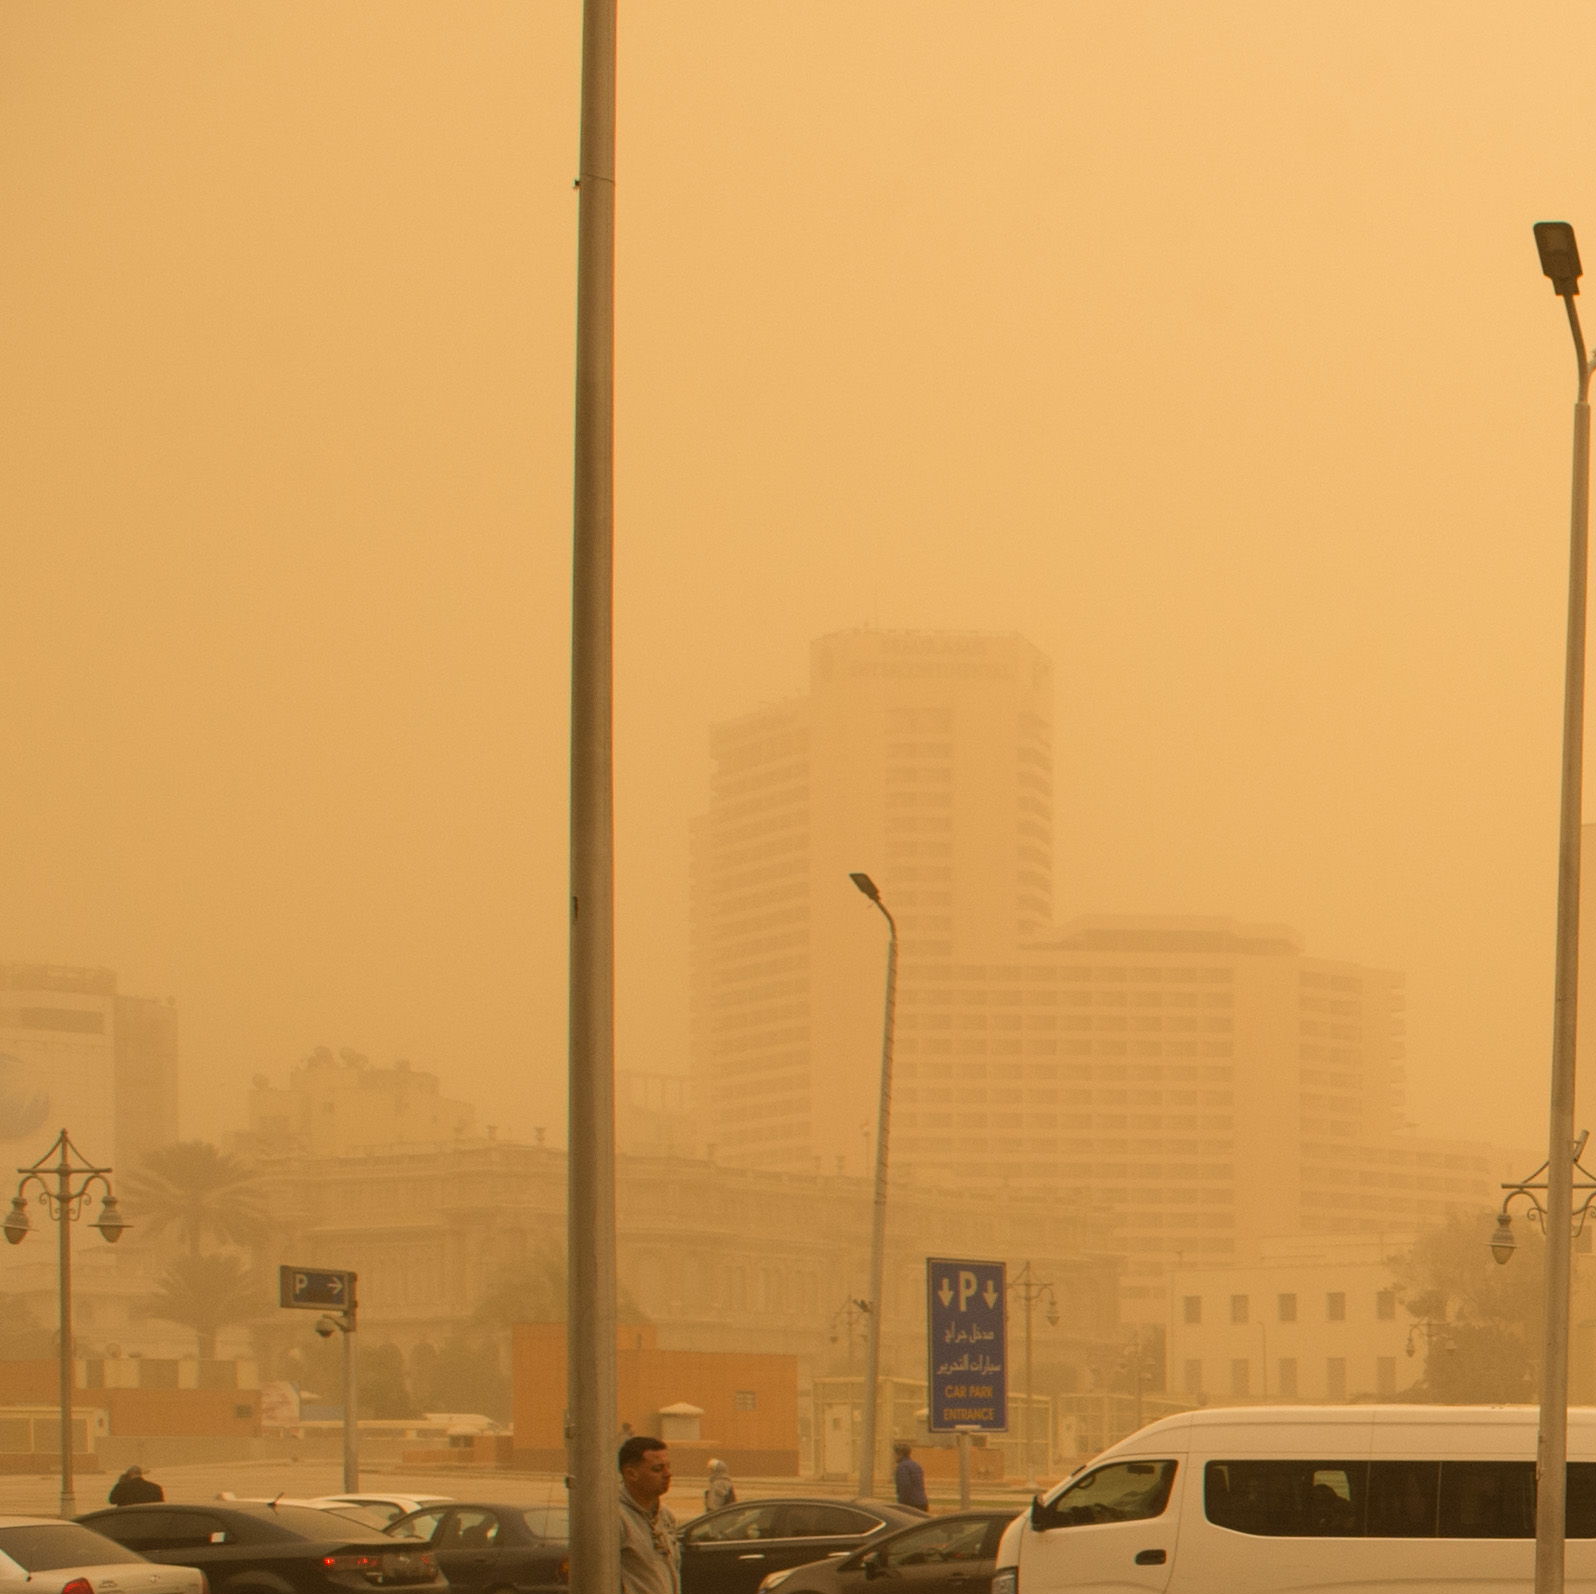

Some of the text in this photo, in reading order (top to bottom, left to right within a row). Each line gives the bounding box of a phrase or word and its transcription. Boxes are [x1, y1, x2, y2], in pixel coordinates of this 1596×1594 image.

[295, 1273, 309, 1295] P
[958, 1270, 978, 1312] P
[936, 1353, 1002, 1376] سيارات التحرير
[945, 1385, 994, 1399] CAR PARK
[943, 1408, 994, 1421] ENTRANCE
